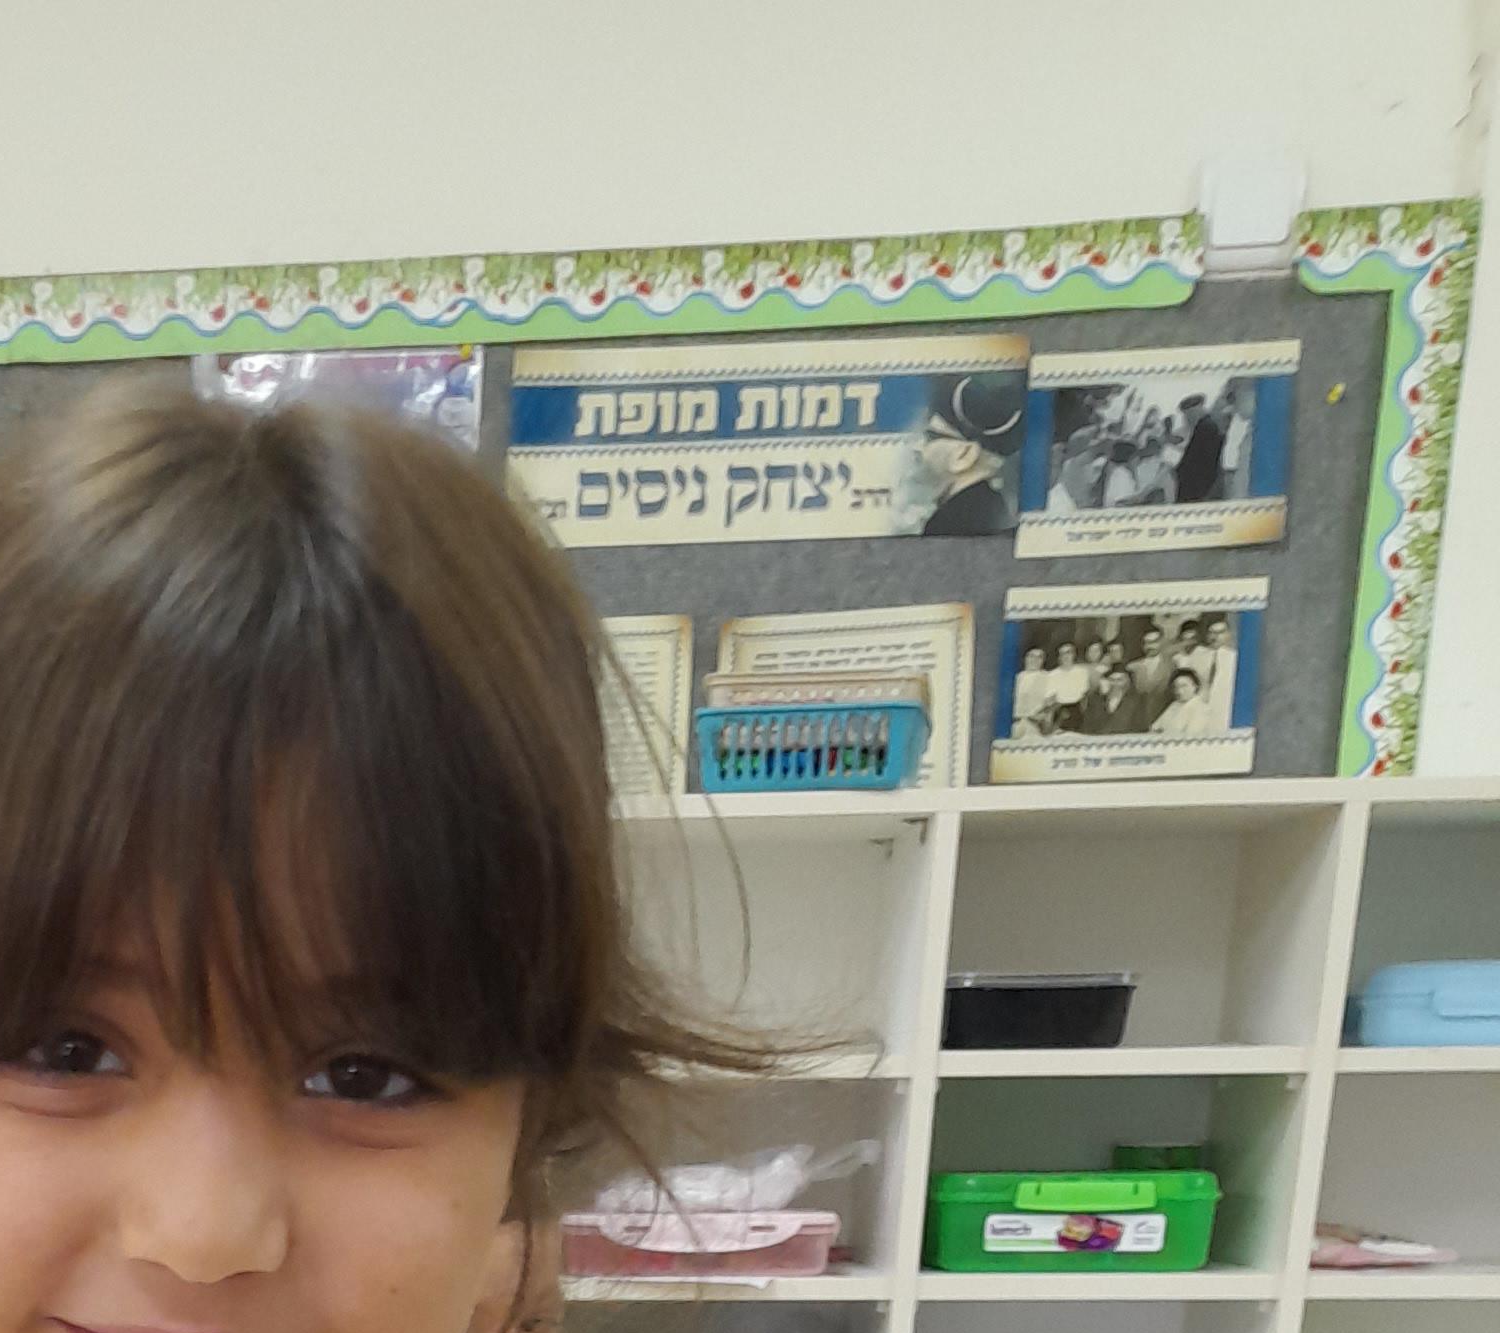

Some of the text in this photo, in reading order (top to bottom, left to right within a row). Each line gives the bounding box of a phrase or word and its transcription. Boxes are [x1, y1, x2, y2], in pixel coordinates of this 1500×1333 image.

[574, 383, 882, 437] דמות מופת
[577, 464, 707, 518] ניסים
[724, 461, 853, 527] יצחק
